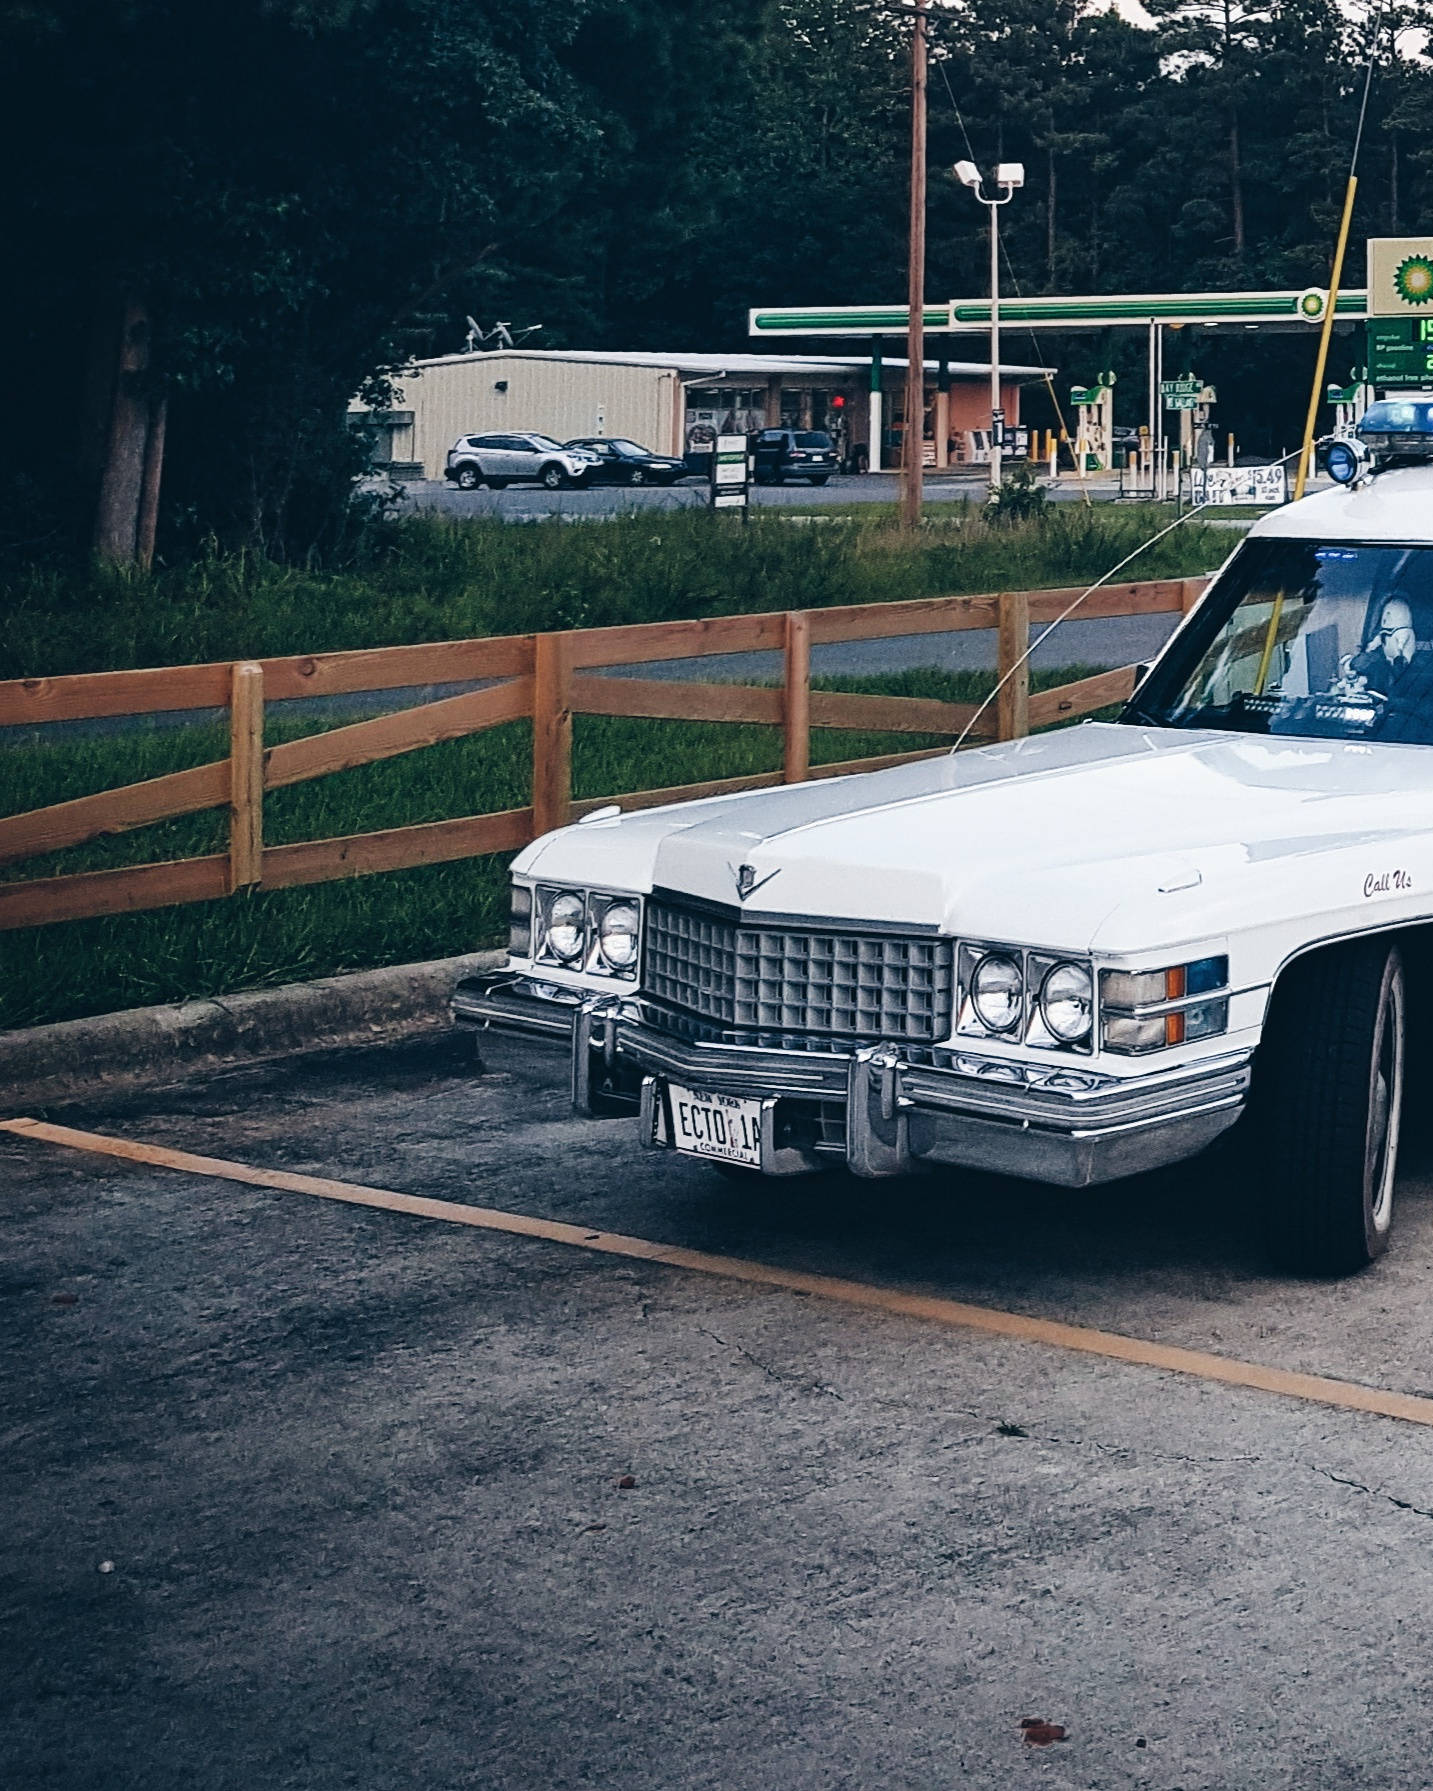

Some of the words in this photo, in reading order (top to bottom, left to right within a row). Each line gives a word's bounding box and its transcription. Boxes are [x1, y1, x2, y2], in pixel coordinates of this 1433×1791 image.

[1363, 873, 1390, 898] Call
[1393, 869, 1412, 889] Us
[679, 1101, 727, 1145] ECTO
